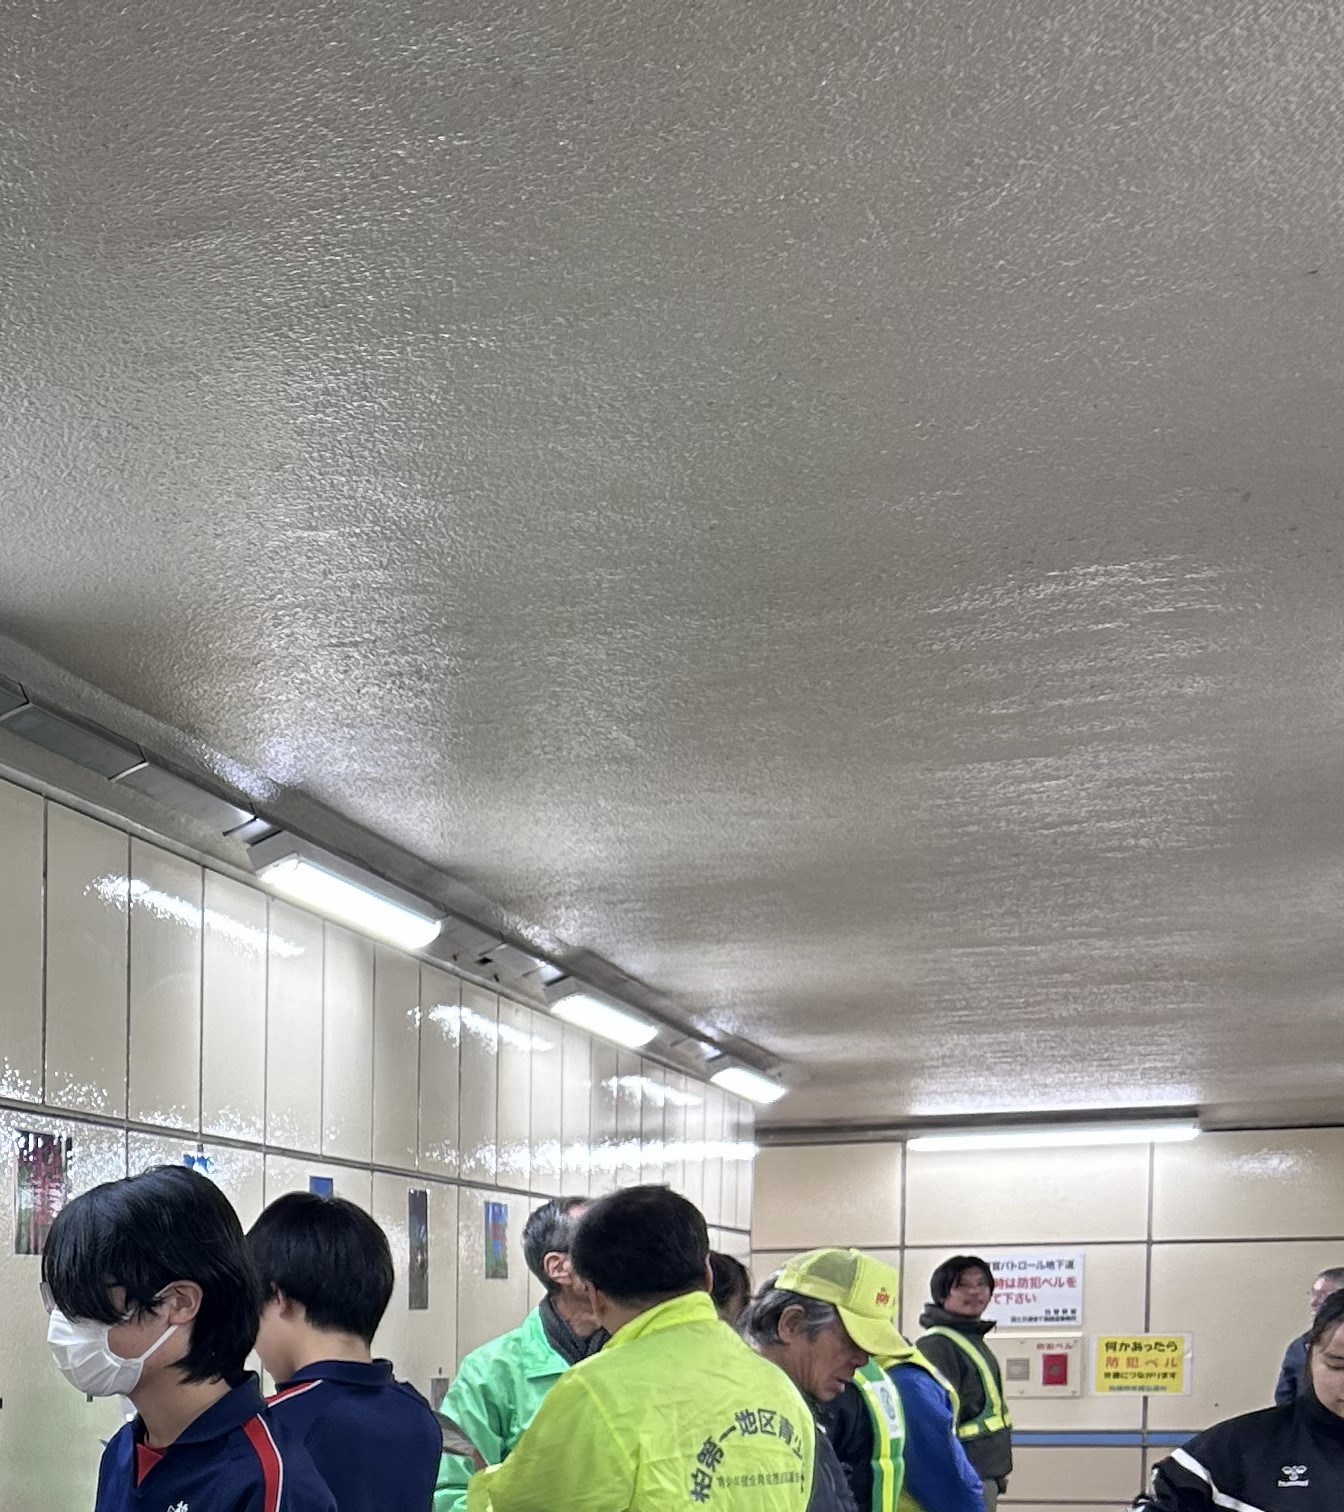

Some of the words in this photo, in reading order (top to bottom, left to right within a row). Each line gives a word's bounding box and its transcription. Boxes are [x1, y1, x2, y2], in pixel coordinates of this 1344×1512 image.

[1105, 1341, 1178, 1352] 何かあったら
[1105, 1356, 1178, 1368] 防犯ベル
